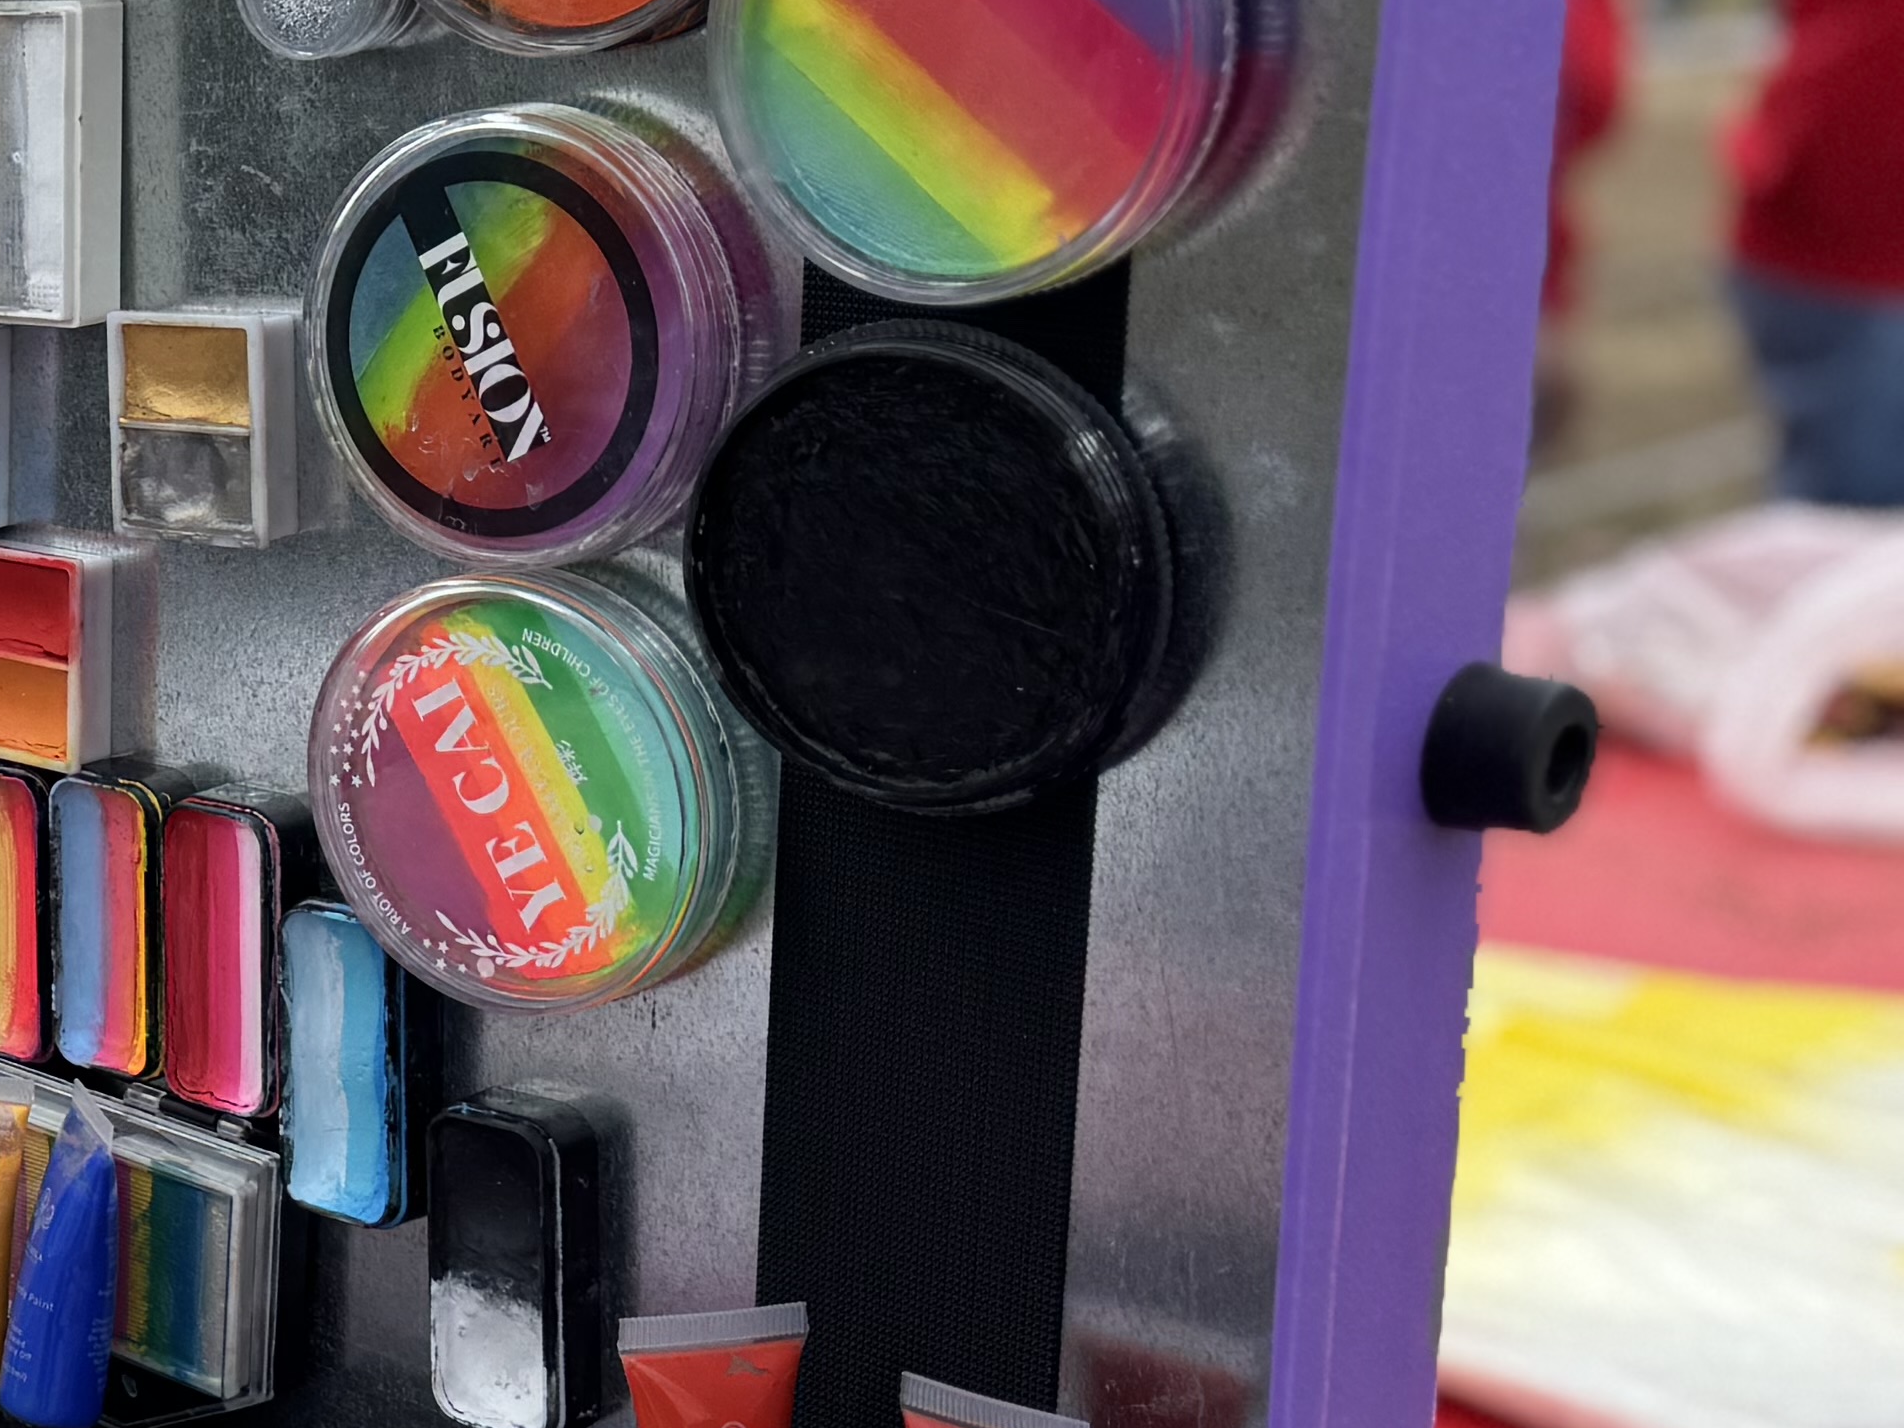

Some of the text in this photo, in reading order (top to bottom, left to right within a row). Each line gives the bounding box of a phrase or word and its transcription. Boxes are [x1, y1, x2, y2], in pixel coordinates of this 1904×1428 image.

[419, 232, 544, 462] FUSION
[433, 325, 476, 401] BODY
[522, 627, 591, 678] CHILDREN
[589, 675, 610, 695] OF
[411, 677, 510, 815] CAI
[608, 693, 635, 735] EYES
[629, 734, 651, 768] THE
[338, 802, 413, 936] A RIOT OF COLORS
[643, 787, 663, 882] MAGICIANS
[485, 820, 567, 934] YE
[28, 1292, 54, 1312] Paint
